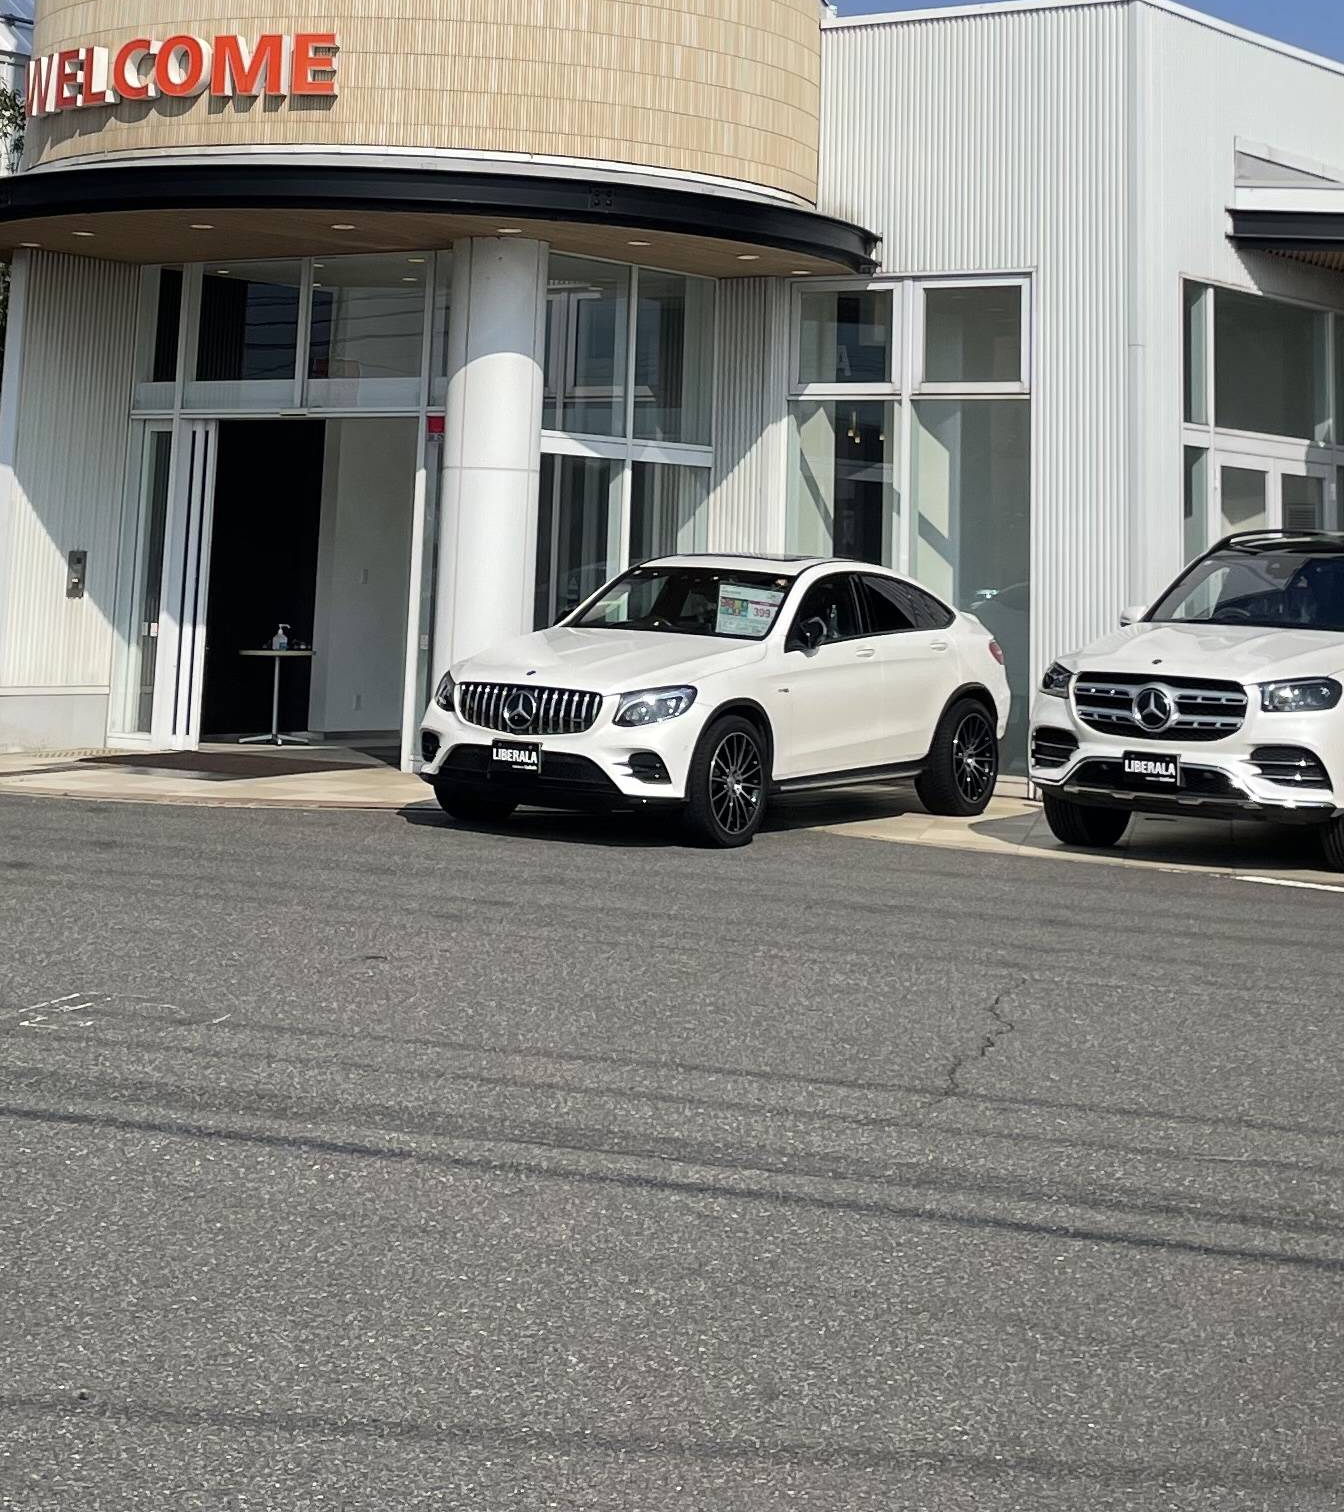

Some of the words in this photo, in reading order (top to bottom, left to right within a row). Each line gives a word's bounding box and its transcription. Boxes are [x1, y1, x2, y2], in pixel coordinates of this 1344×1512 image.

[24, 33, 339, 117] WELCOME
[493, 748, 538, 764] LIBERALA
[1124, 759, 1176, 776] LIBERALA
